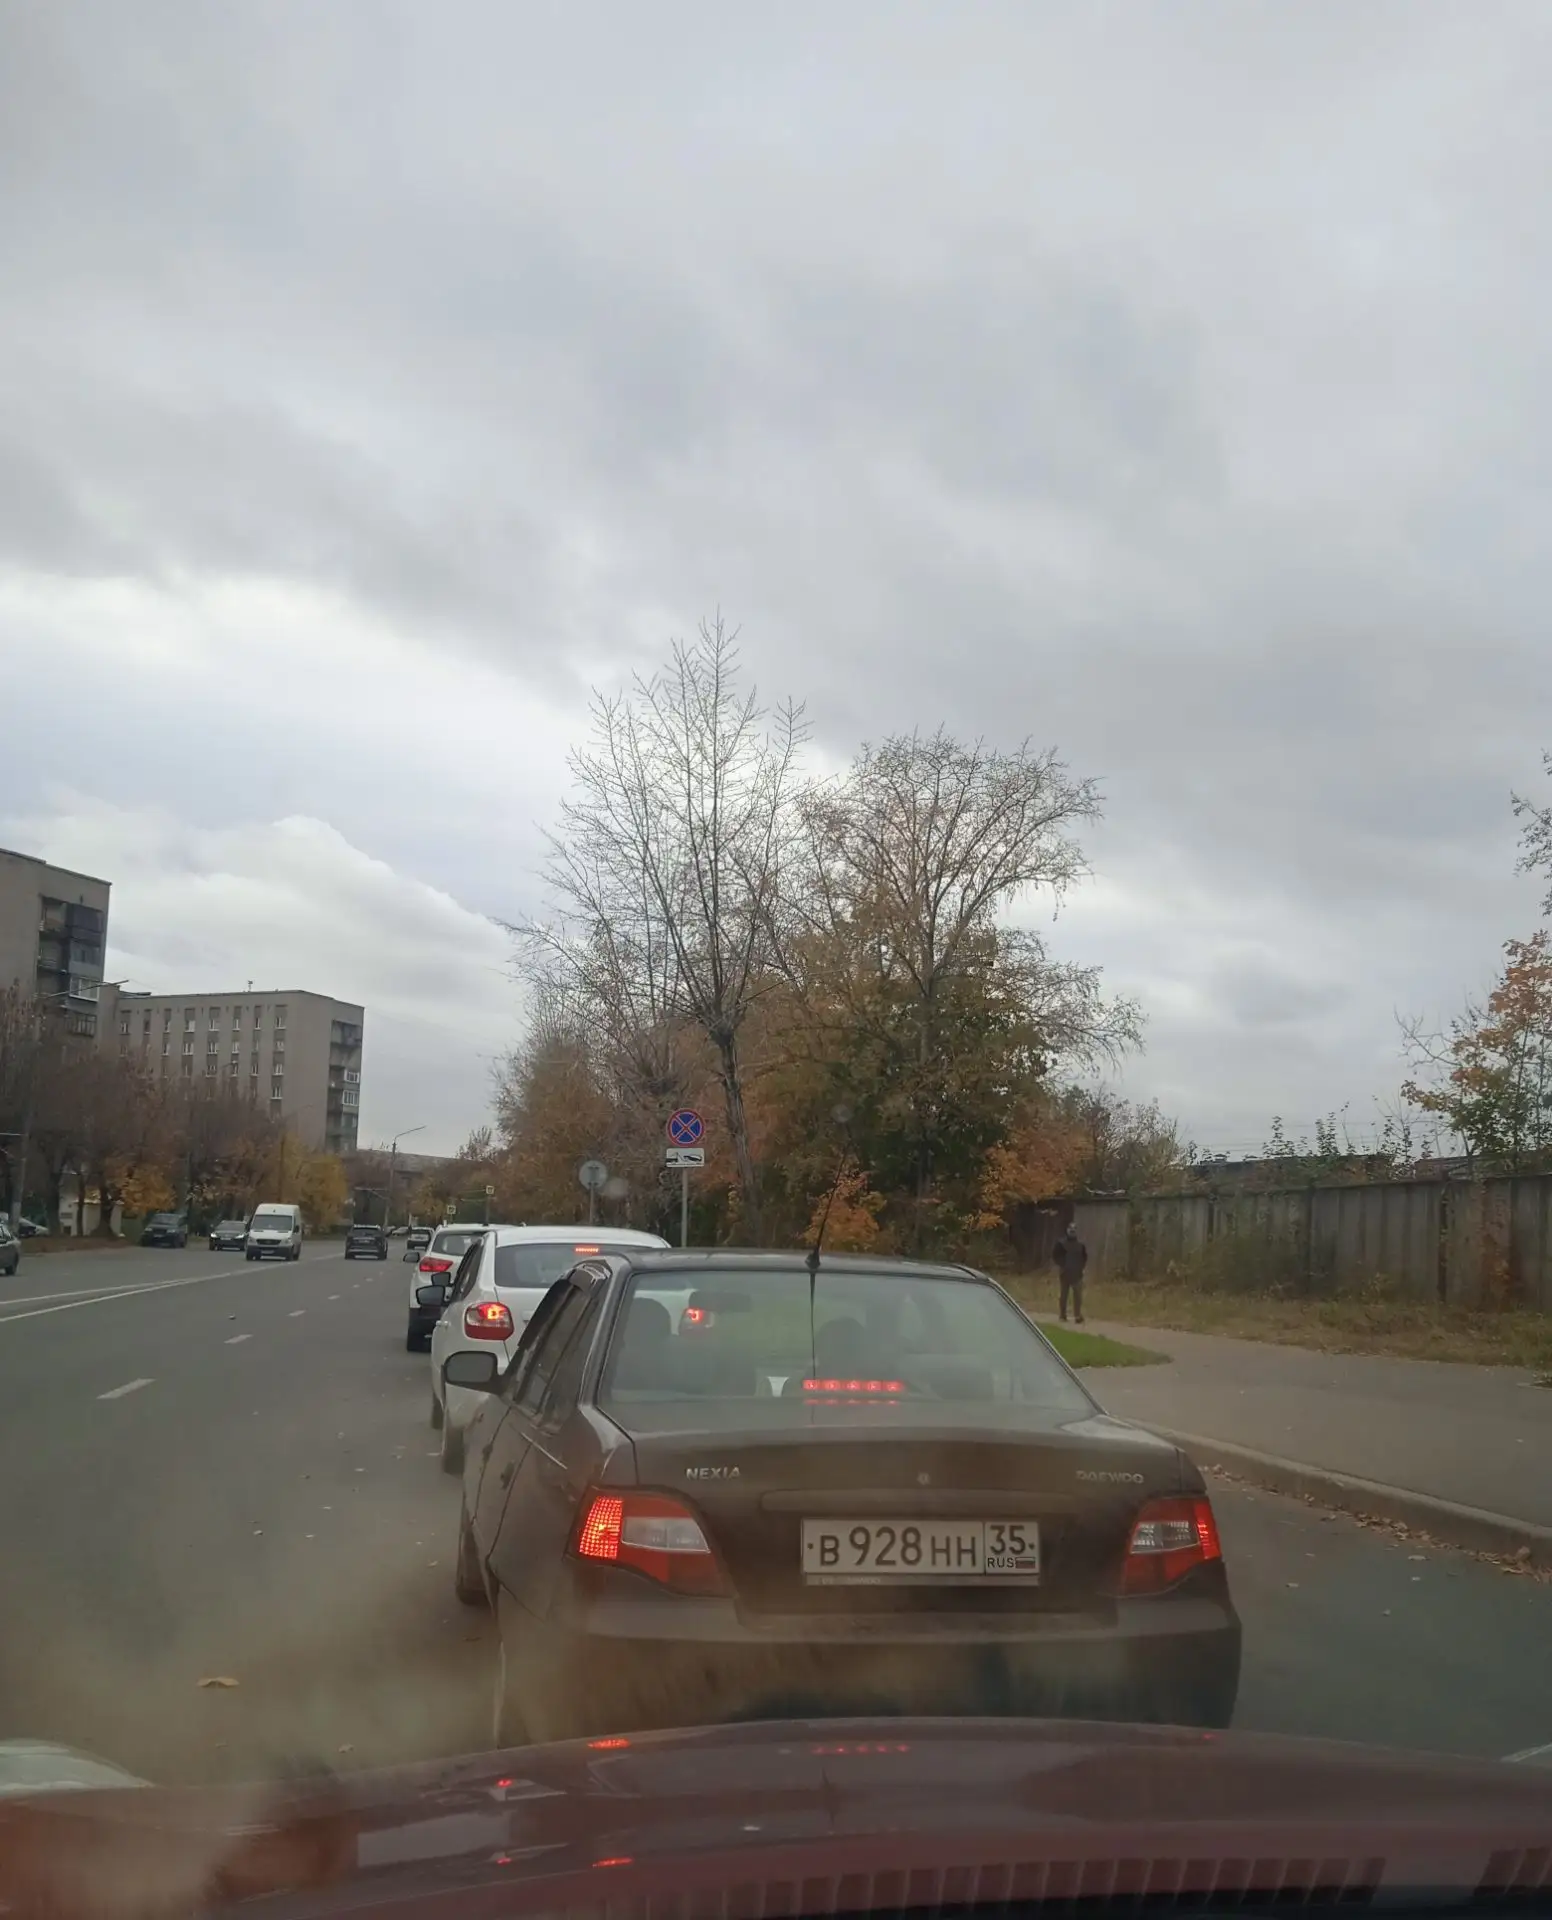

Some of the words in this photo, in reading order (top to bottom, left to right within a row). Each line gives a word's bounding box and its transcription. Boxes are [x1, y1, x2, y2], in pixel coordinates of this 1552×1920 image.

[686, 1466, 741, 1480] NEXIA
[989, 1525, 1027, 1555] 35
[987, 1557, 1016, 1569] RUS
